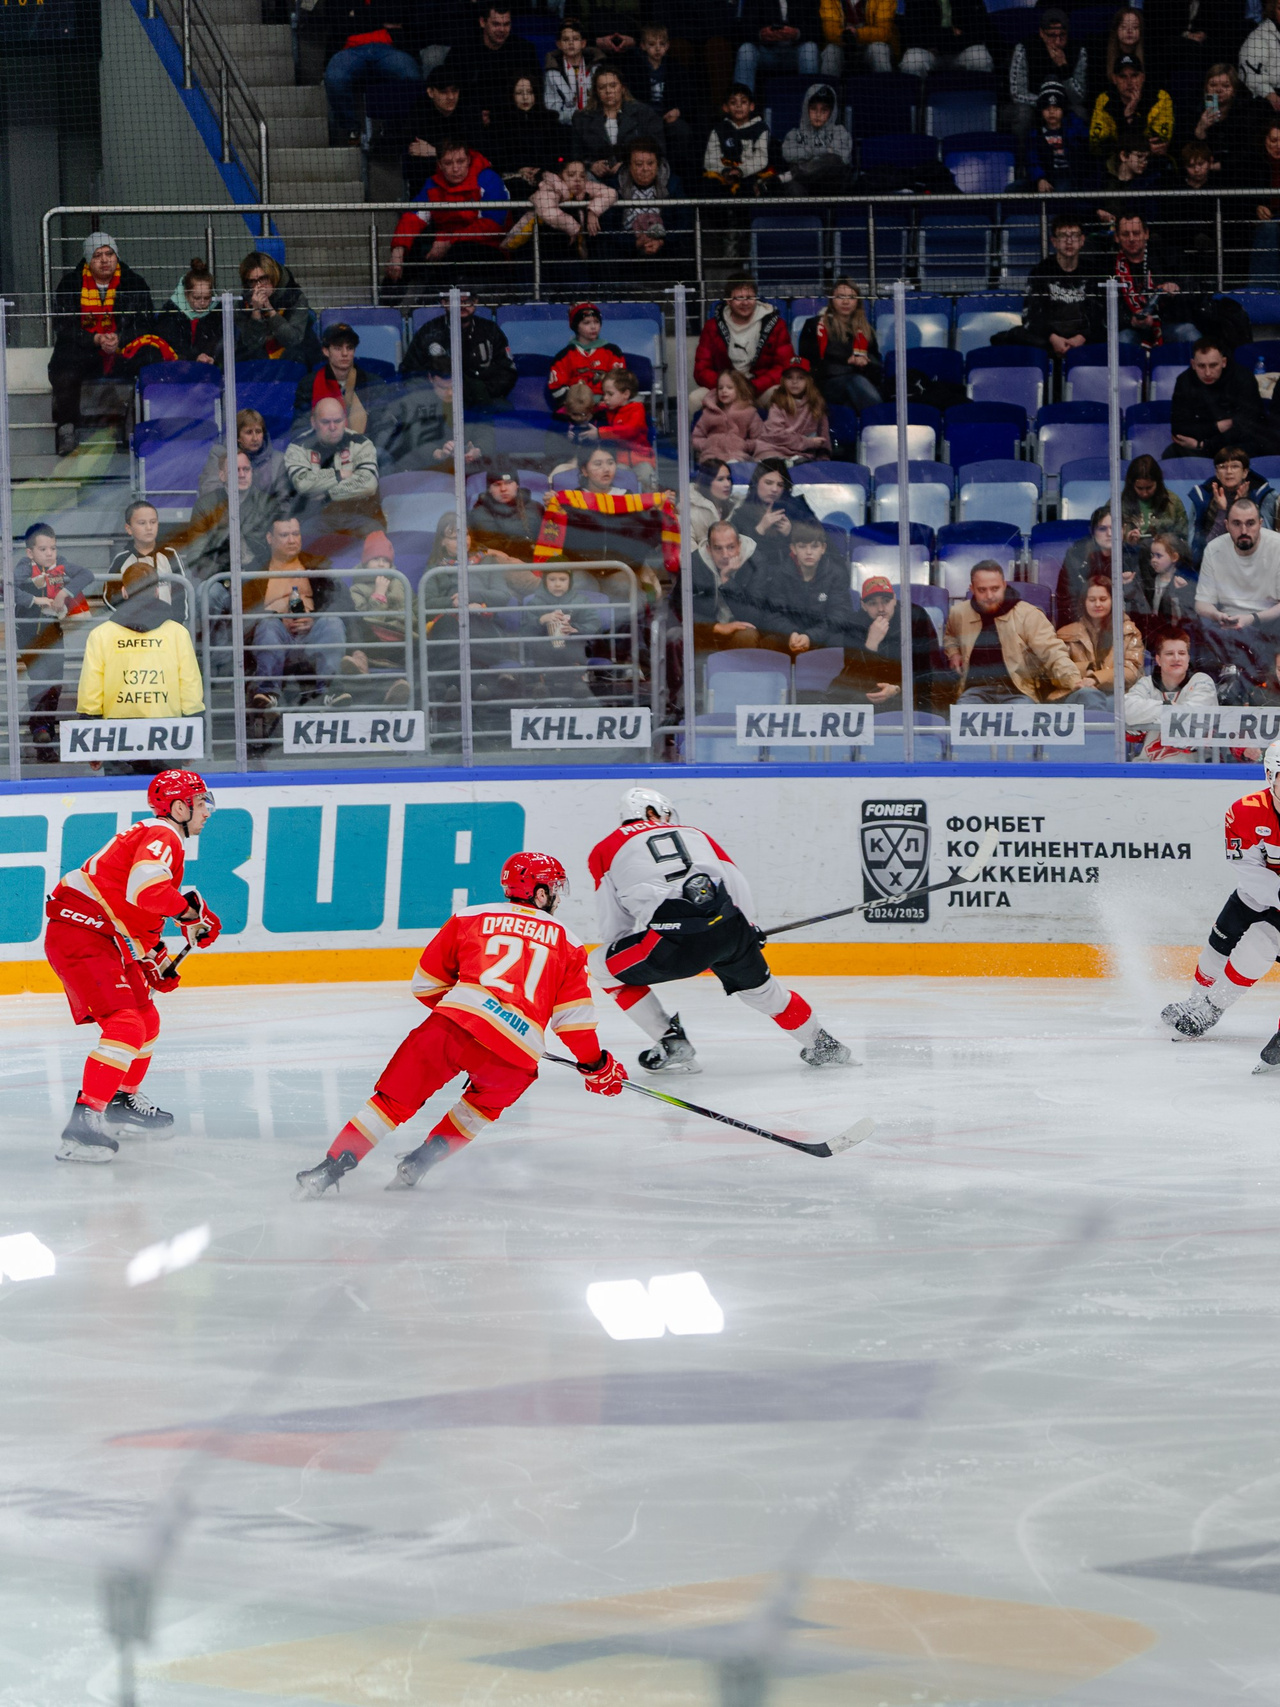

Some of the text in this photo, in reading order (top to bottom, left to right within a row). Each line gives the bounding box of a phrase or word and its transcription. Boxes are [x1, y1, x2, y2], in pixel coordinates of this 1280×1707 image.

[117, 638, 163, 649] SAFETY
[116, 691, 169, 704] SAFETY
[292, 719, 416, 745] KHL.RU
[520, 715, 643, 741] KHL.RU
[745, 712, 866, 738] KHL.RU
[959, 711, 1076, 737] KHL.RU
[70, 726, 194, 752] KHL.RU
[865, 804, 923, 816] FONBET
[946, 815, 1046, 833] ФОНБЕТ
[147, 839, 173, 867] 40
[646, 830, 694, 883] 9
[947, 841, 1192, 860] КОТИНЕНТАЛЬНАЯ
[947, 862, 1100, 884] ХККЕЙНАЯ
[947, 891, 1012, 908] ЛИГА
[59, 908, 105, 929] CCM
[868, 908, 925, 918] 2024/2025
[482, 916, 560, 946] O'REGAN
[479, 935, 550, 1004] 21
[482, 998, 530, 1037] SIBUR
[708, 1110, 774, 1140] VAPOR
